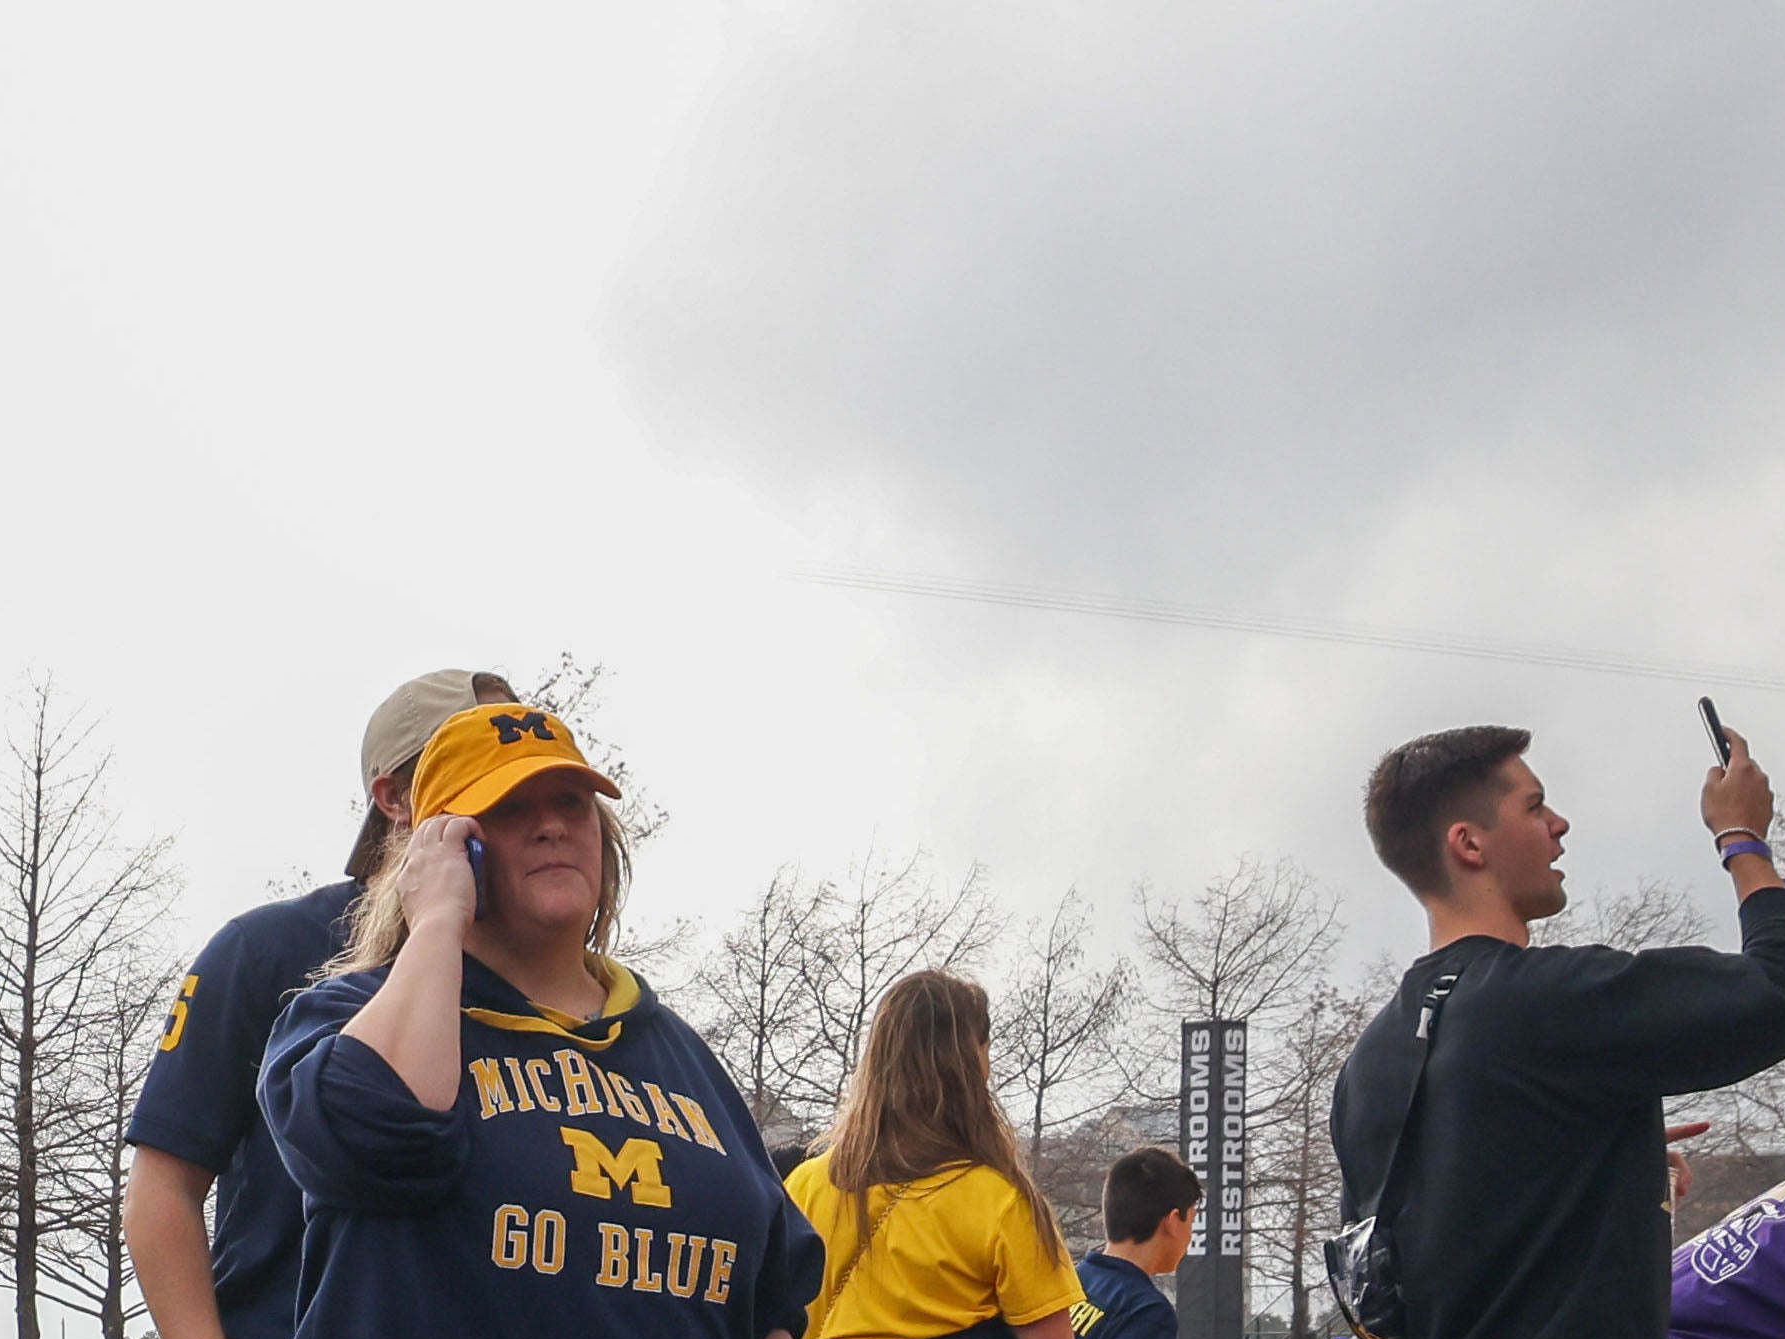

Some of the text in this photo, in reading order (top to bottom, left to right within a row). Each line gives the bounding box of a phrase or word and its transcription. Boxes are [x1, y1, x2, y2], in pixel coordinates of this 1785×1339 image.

[489, 711, 557, 745] M
[468, 1048, 728, 1157] MICHIGAN
[1186, 1029, 1211, 1257] RETROOMS
[1221, 1028, 1245, 1256] RESTROOMS
[559, 1125, 672, 1209] M
[491, 1203, 738, 1305] GO BLUE
